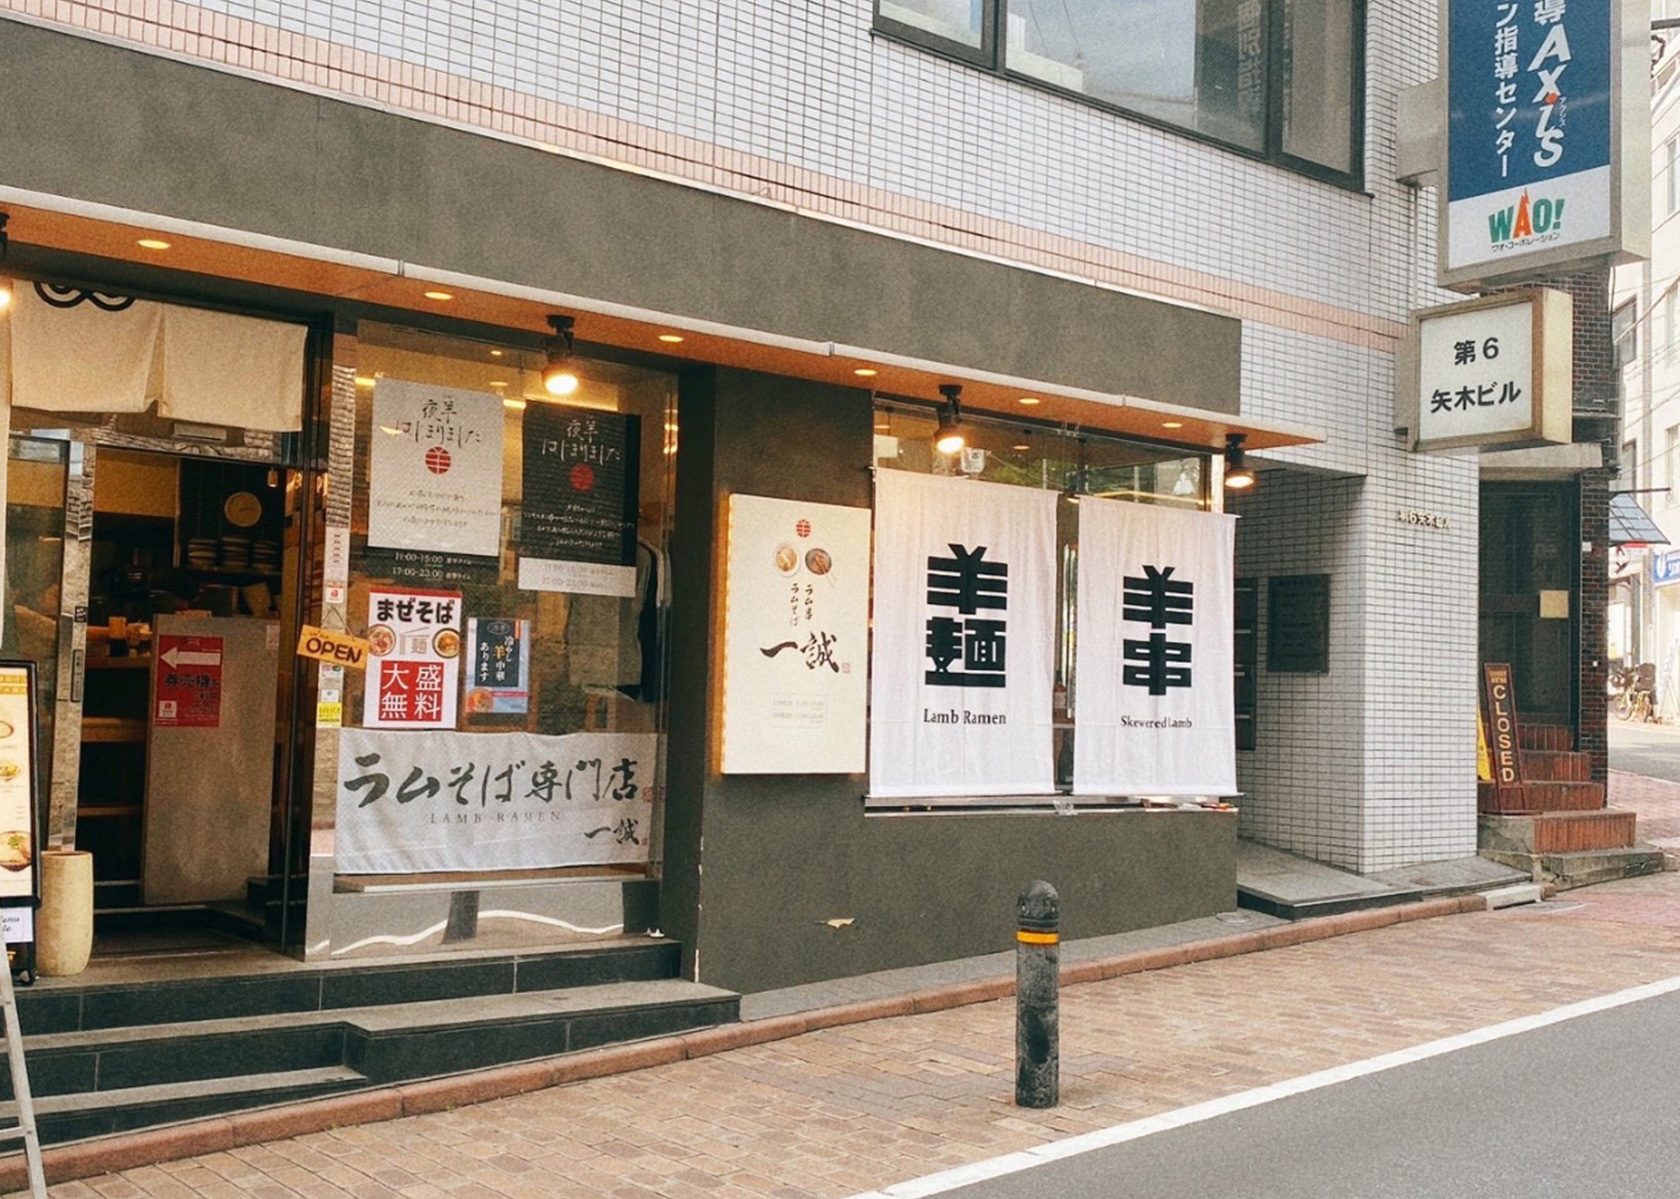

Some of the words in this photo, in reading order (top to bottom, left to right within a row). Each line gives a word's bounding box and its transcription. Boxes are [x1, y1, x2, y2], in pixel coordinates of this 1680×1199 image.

[1488, 187, 1565, 243] WAO!
[1430, 381, 1522, 413] 矢木ビル
[377, 598, 456, 624] まぜそば
[1122, 565, 1194, 696] 羊串
[306, 636, 363, 664] OPEN
[480, 641, 490, 682] あります
[760, 631, 840, 674] 一誠
[382, 663, 442, 692] 大盛
[381, 692, 441, 720] 無料
[924, 708, 959, 725] Lamb
[963, 709, 1007, 726] Ramen
[1493, 684, 1515, 783] CLOSED
[344, 753, 639, 808] ラムそば専門店
[430, 812, 483, 825] LAMB
[497, 811, 562, 823] RAMEN
[584, 817, 640, 847] 一誠
